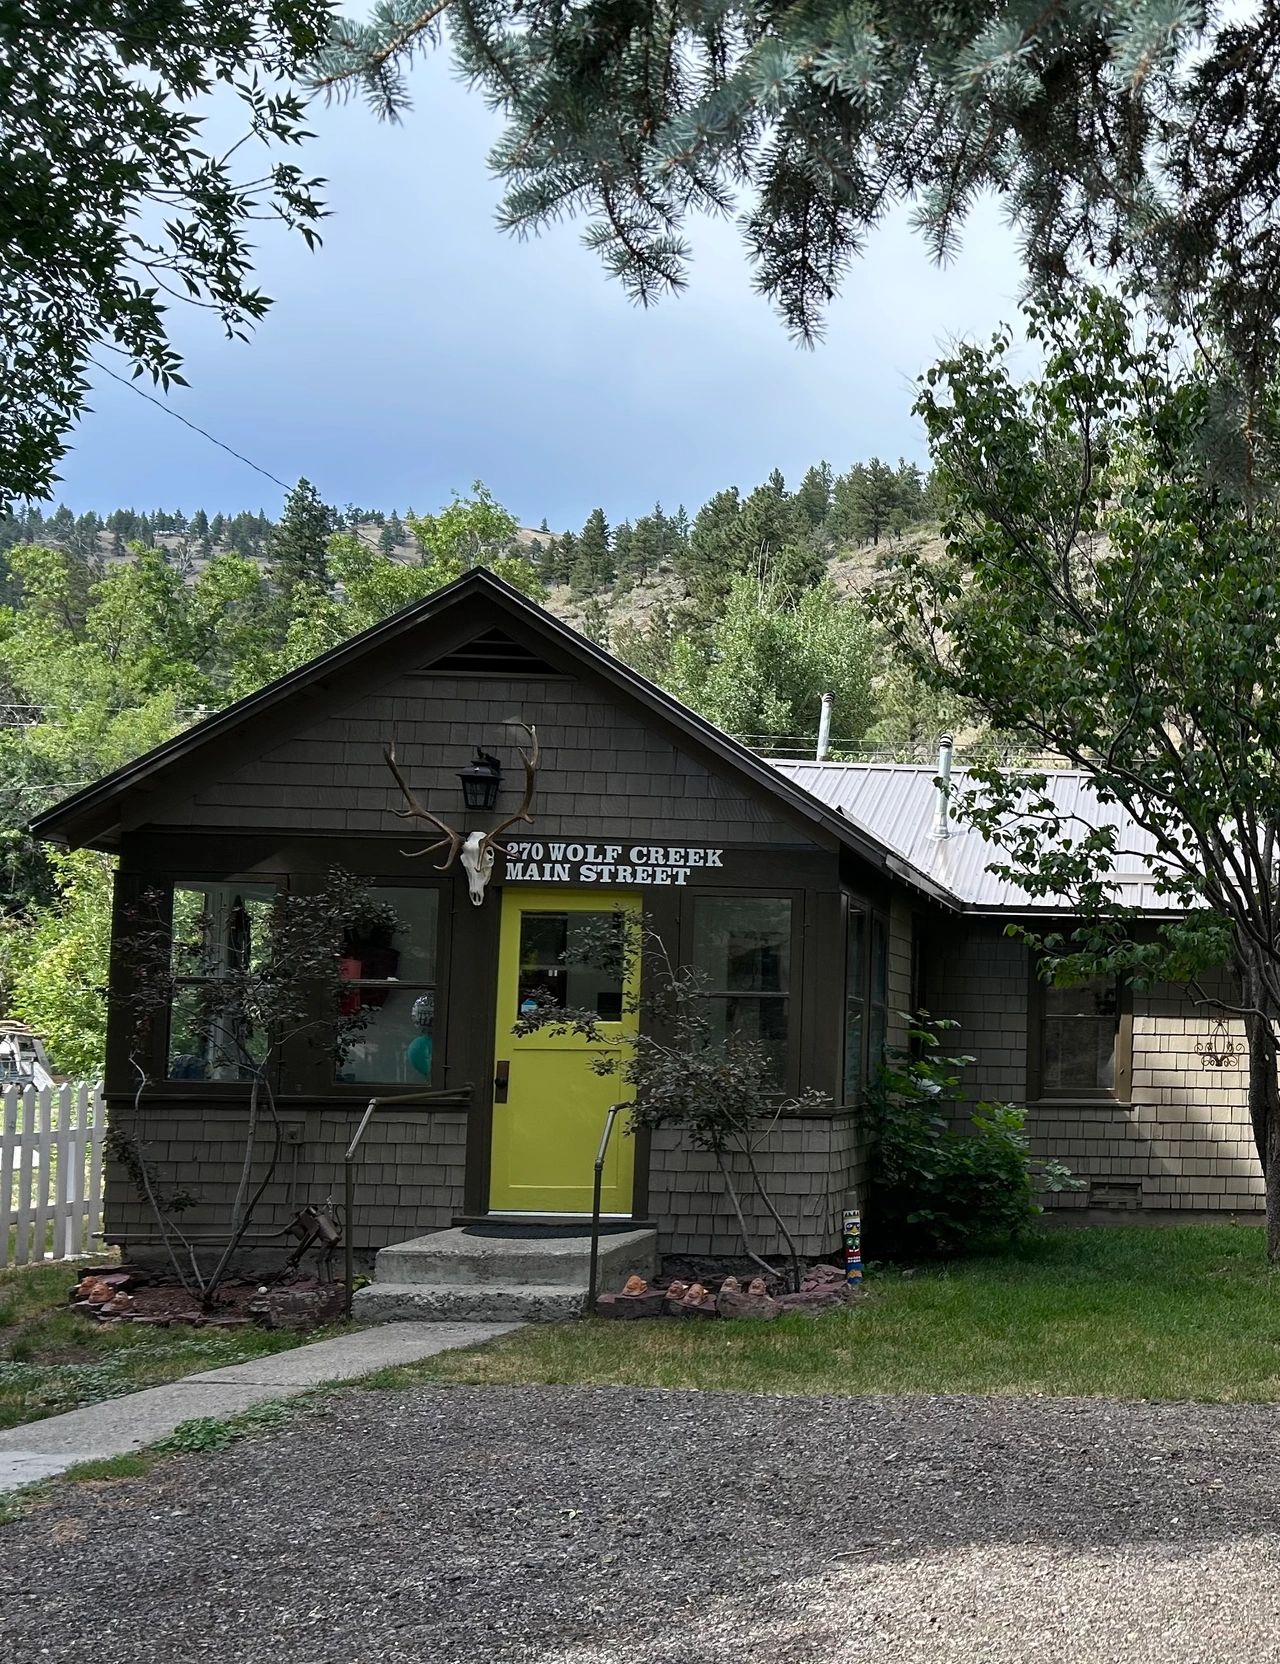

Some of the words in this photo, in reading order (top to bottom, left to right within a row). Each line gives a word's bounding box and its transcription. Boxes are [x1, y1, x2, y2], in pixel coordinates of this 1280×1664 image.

[506, 842, 544, 860] 270
[548, 843, 622, 862] WOLF
[630, 846, 724, 867] CREEK
[505, 862, 571, 881] MAIN
[579, 864, 691, 885] STREET
